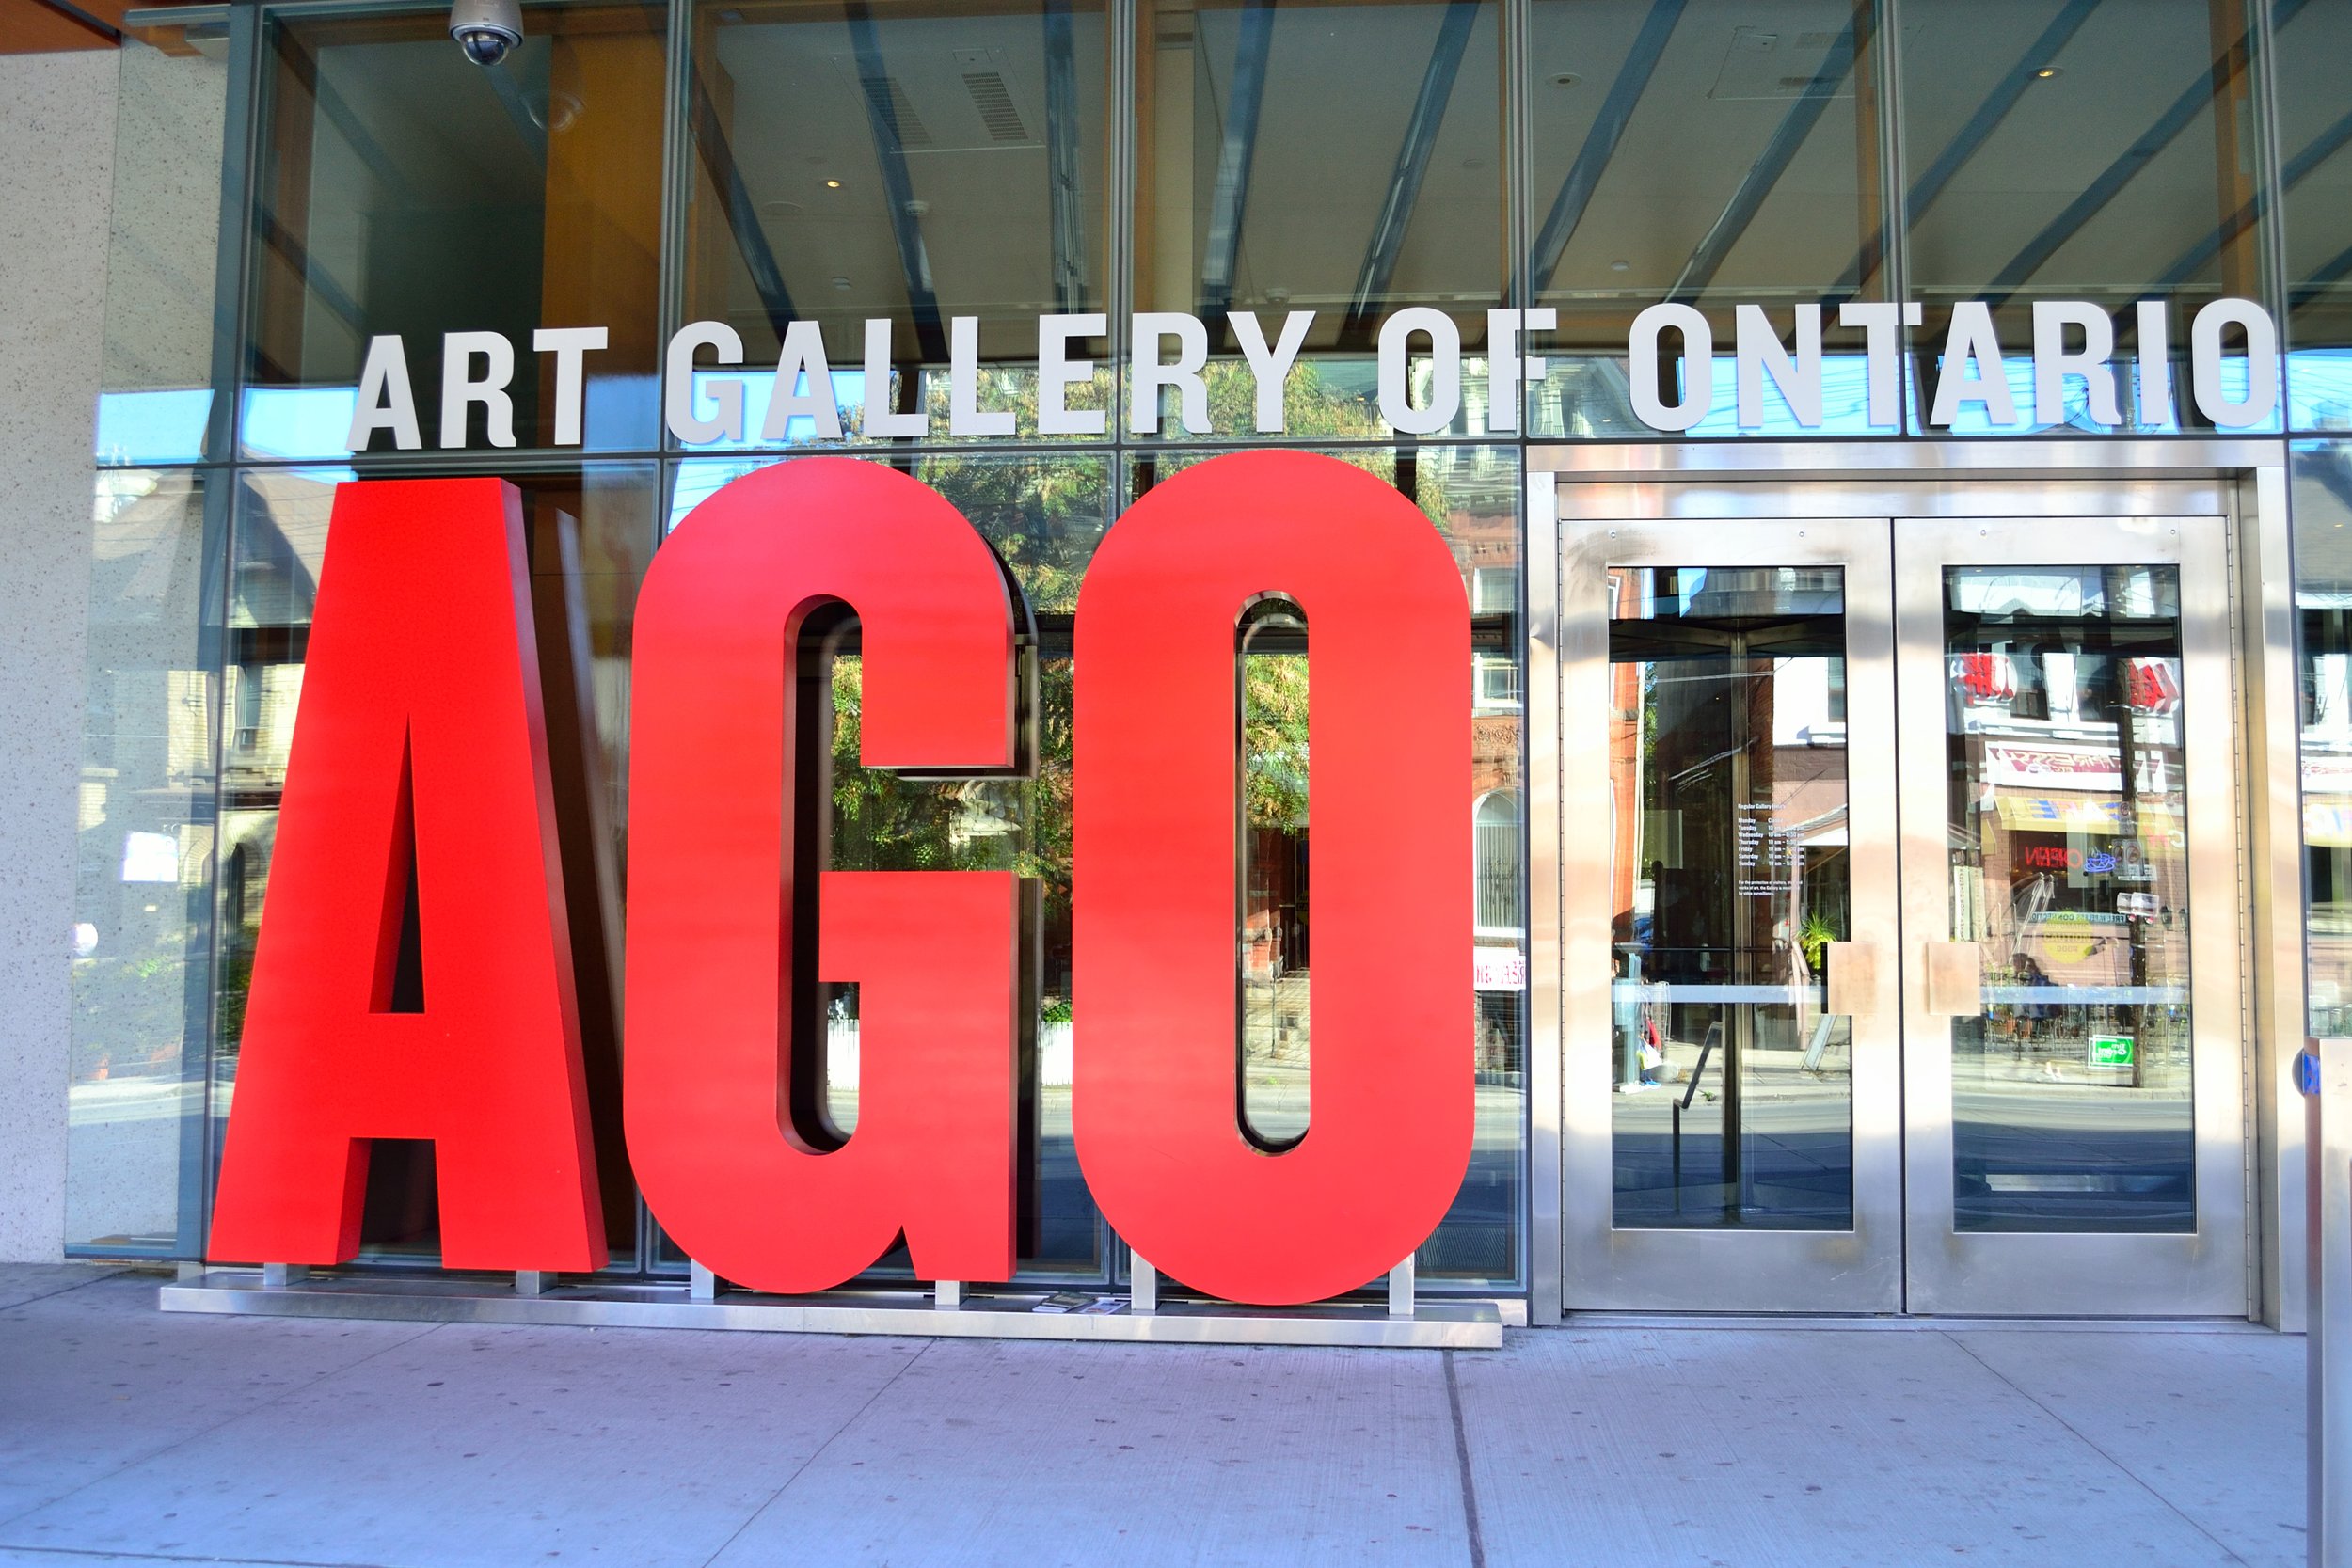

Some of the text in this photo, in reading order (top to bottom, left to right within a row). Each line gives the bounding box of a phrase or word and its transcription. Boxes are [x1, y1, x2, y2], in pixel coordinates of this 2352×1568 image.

[346, 298, 2277, 451] ART GALLERY OF ONTARIO
[208, 448, 1474, 1306] AGO
